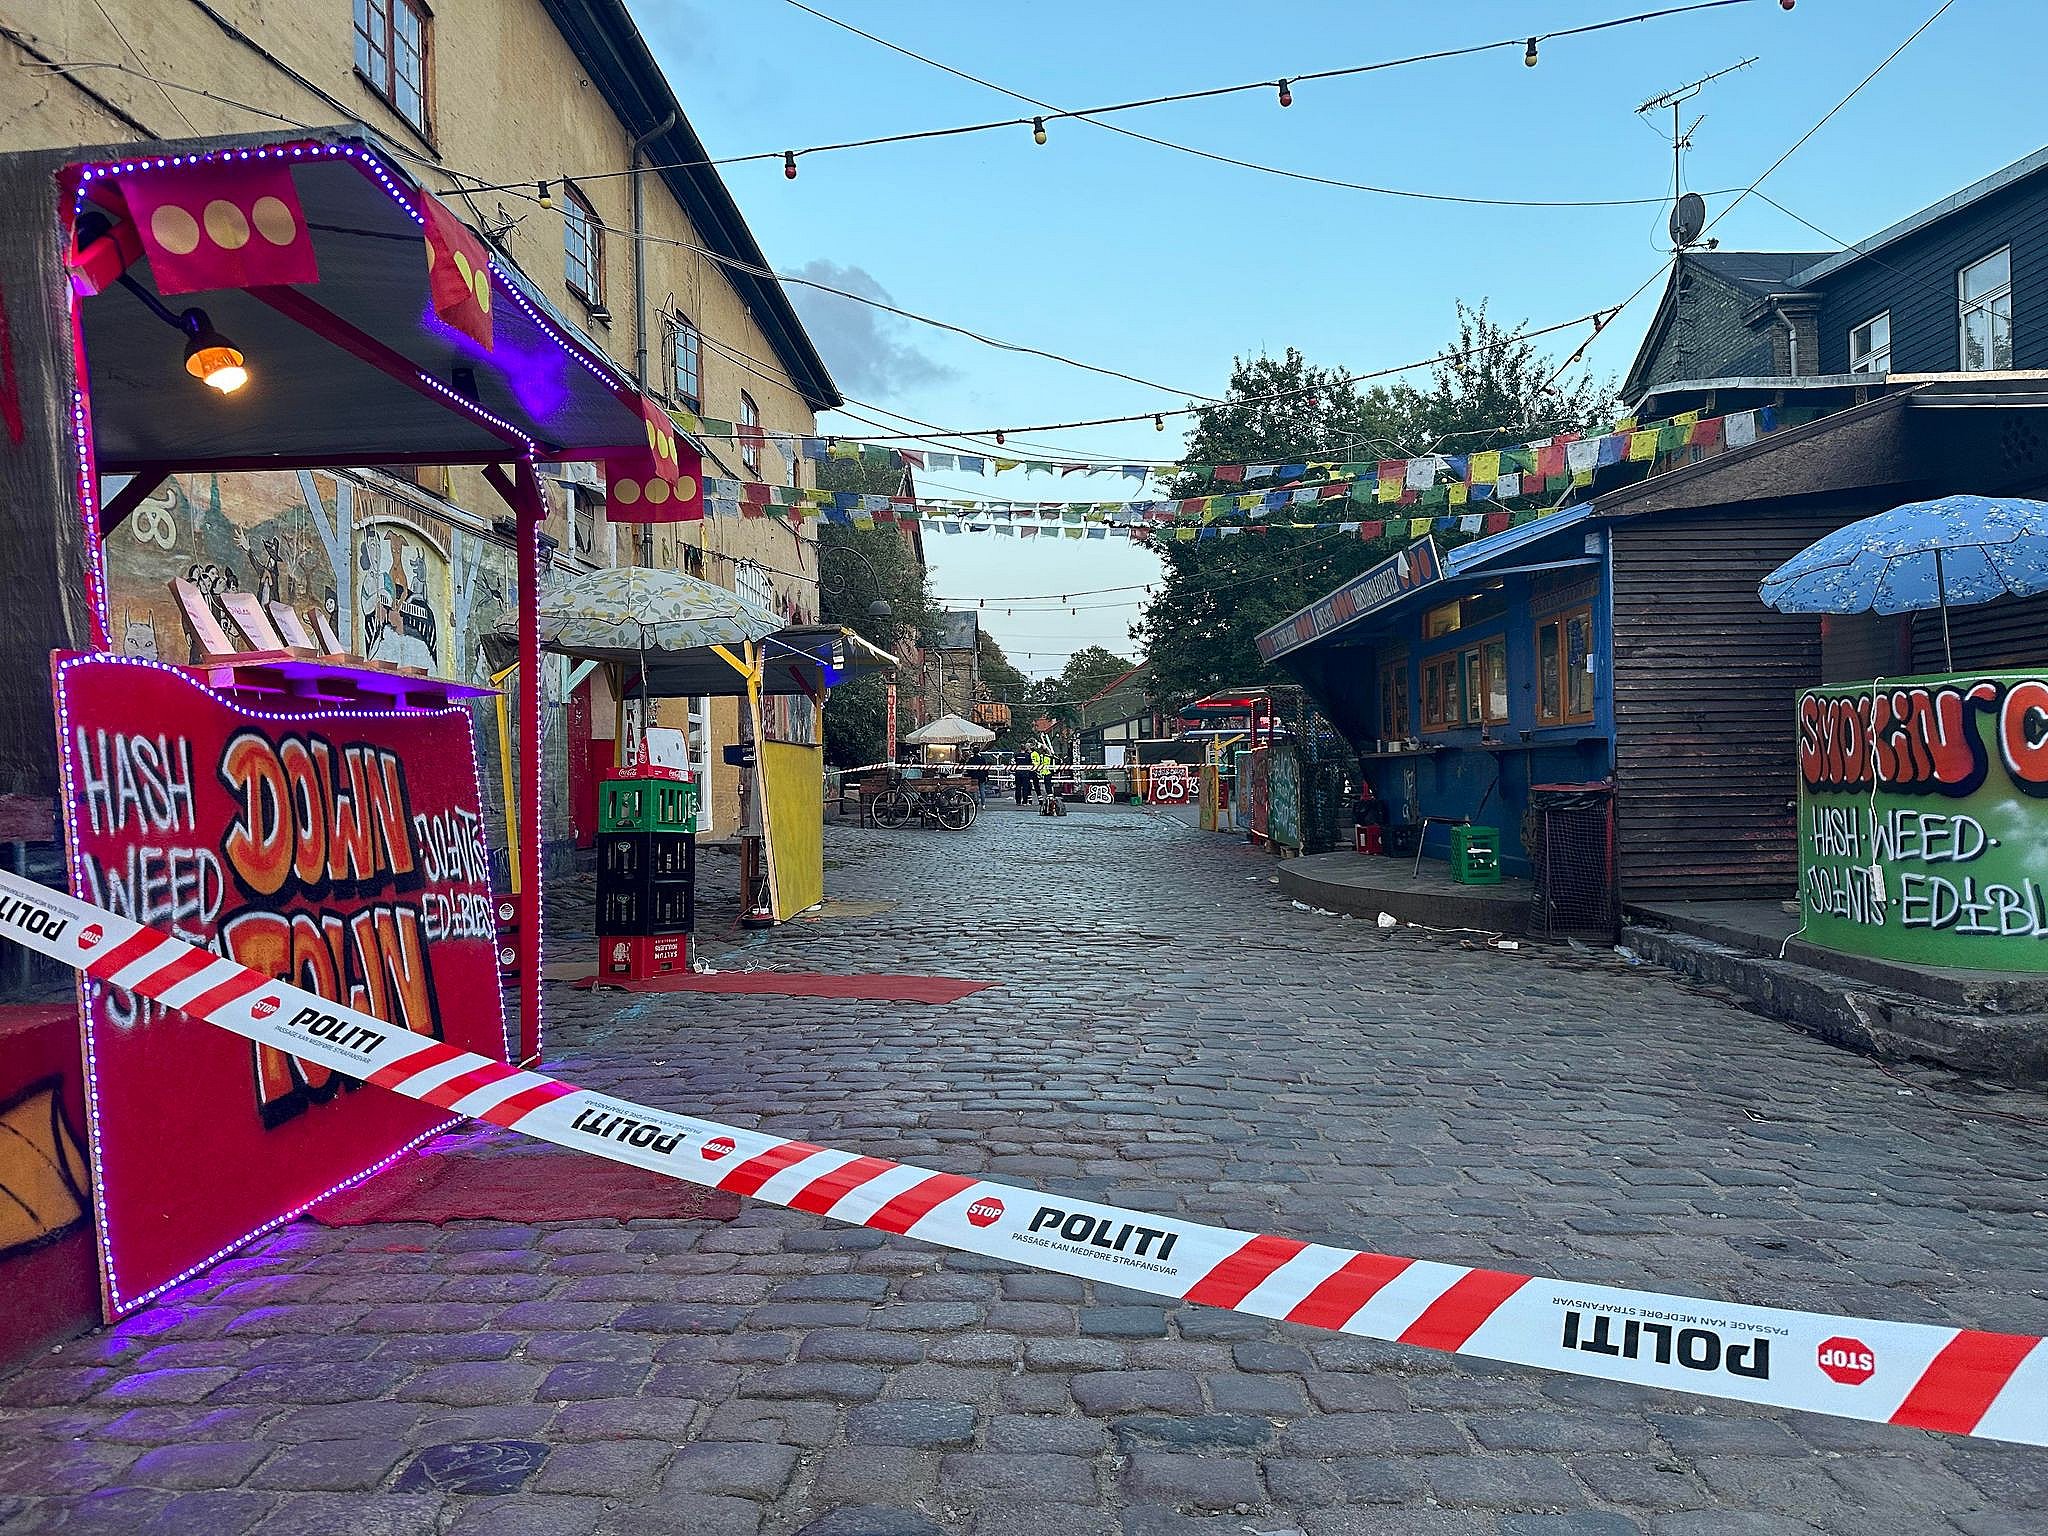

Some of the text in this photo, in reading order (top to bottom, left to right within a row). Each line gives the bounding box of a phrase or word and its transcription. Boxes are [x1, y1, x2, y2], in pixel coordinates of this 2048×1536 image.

[76, 726, 195, 834] HASH
[219, 729, 418, 900] DOWN
[1812, 805, 1986, 861] HASH WEED
[82, 844, 225, 925] WEED
[80, 930, 101, 944] STOP
[254, 1001, 387, 1054] STOP POLITI
[571, 1108, 734, 1155] POLITI STOP
[968, 1203, 1179, 1261] STOP POLITI
[1011, 1232, 1178, 1276] PASSAGE KAN MEDFØRE STRAFANSVAR
[1552, 1296, 1790, 1337] PASSAGE KAN MEDFØRE STRAFANSVAR
[1562, 1310, 1874, 1380] POLITI STOP
